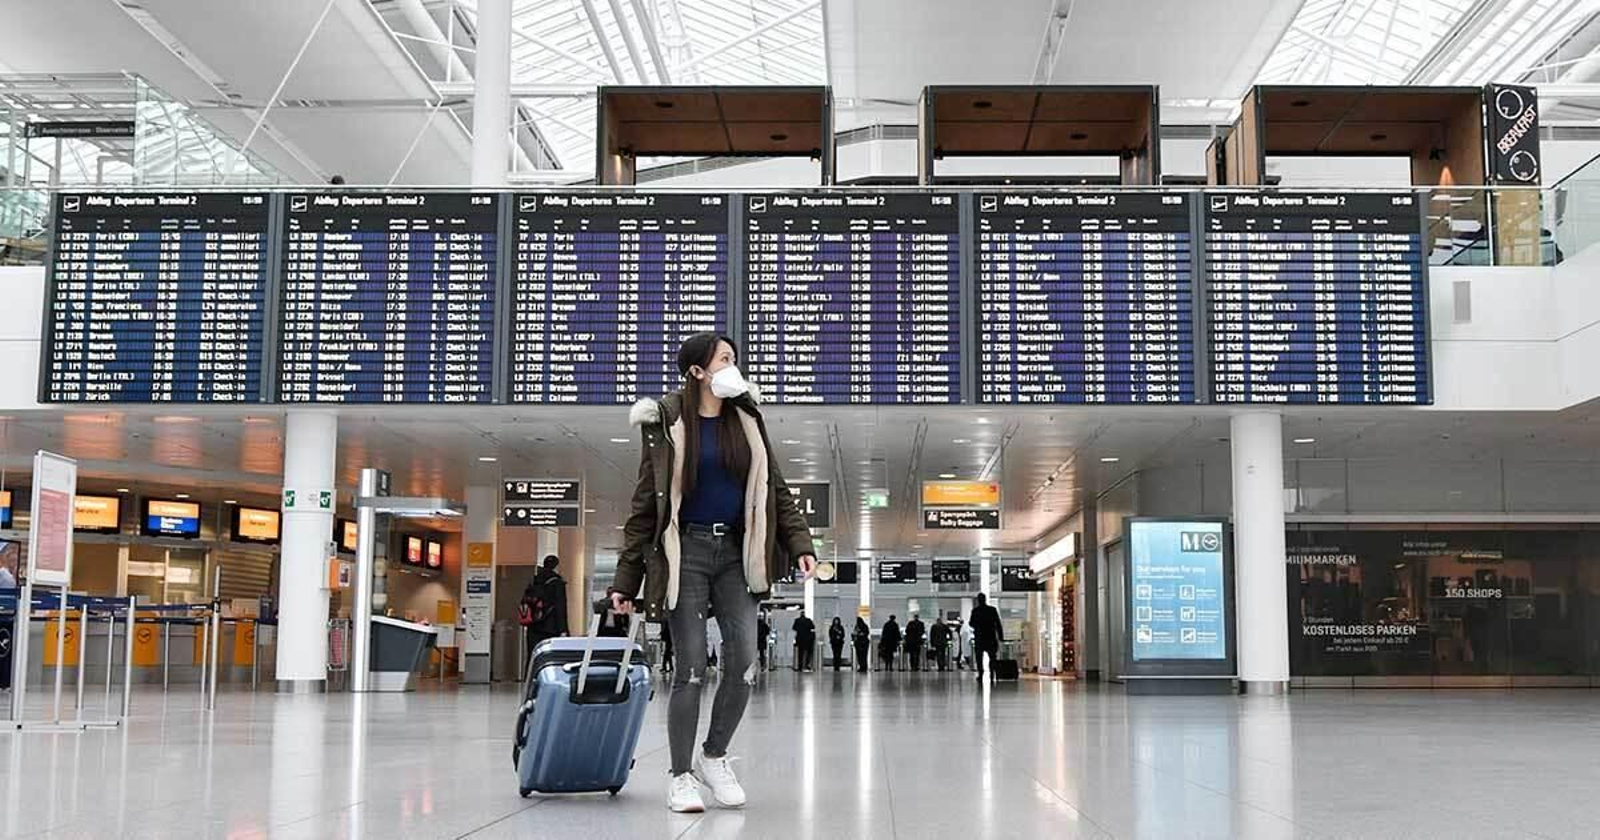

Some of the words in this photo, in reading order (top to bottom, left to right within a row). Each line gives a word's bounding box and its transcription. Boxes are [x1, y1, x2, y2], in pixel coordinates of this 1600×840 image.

[1496, 104, 1537, 155] BREAKFAST
[86, 196, 111, 206] Abflug
[114, 196, 155, 206] Departures
[158, 196, 189, 205] Terminal
[191, 196, 197, 205] 2
[314, 196, 339, 206] Abflug
[342, 196, 382, 206] Departures
[386, 196, 417, 205] Terminal
[419, 196, 425, 205] 2
[543, 196, 568, 207] Abflug
[572, 196, 612, 207] Departures
[615, 196, 646, 205] Terminal
[648, 196, 654, 205] 2
[773, 197, 798, 207] Abflug
[802, 197, 842, 207] Departures
[845, 197, 877, 206] Terminal
[879, 197, 885, 206] 2
[1004, 196, 1029, 206] Abflug
[1032, 196, 1073, 206] Departures
[1076, 196, 1107, 205] Terminal
[1109, 196, 1115, 205] 2
[1234, 196, 1259, 207] Abflug
[1262, 196, 1303, 206] Departures
[1306, 196, 1337, 205] Terminal
[1339, 196, 1345, 205] 2
[806, 498, 815, 513] L
[1182, 534, 1198, 550] M
[1445, 588, 1465, 598] 150
[1467, 588, 1502, 598] SHOPS
[1303, 625, 1375, 635] KOSTENLOSES
[1376, 625, 1416, 635] PARKEN
